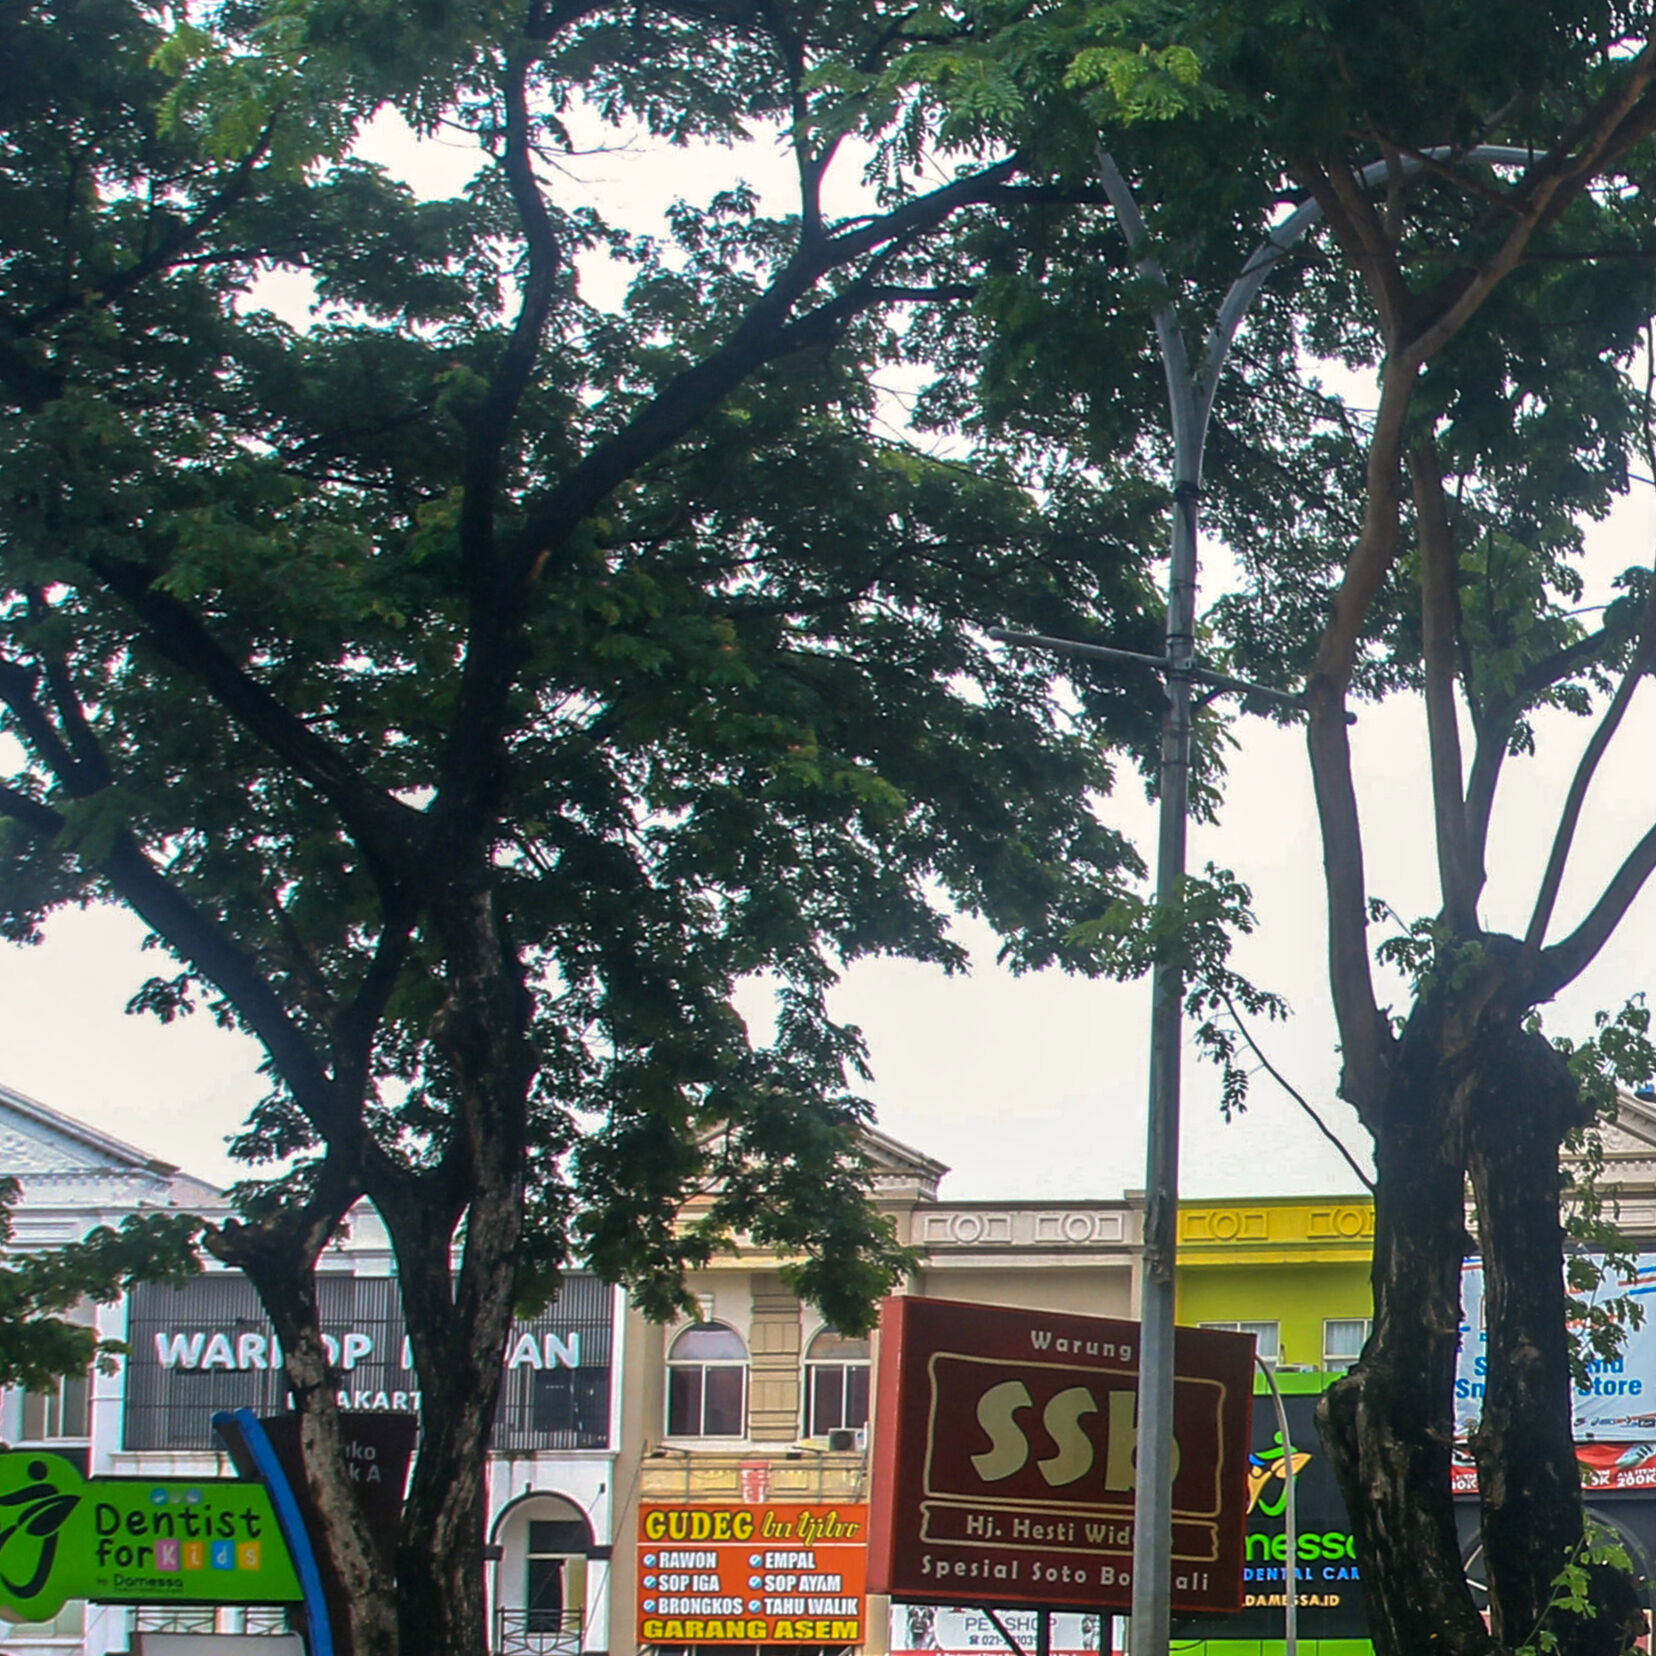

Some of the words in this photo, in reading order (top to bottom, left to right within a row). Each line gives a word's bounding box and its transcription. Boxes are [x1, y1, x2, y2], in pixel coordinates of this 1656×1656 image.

[1030, 1330, 1132, 1361] Warung
[95, 1502, 262, 1538] Dentist
[644, 1510, 755, 1541] GUDEG
[965, 1514, 1002, 1539] Hj.
[1012, 1518, 1075, 1541] Hesti
[96, 1540, 153, 1569] for
[657, 1552, 718, 1569] RAWON
[764, 1552, 817, 1570] EMPAL
[921, 1555, 1019, 1581] Spesial
[1031, 1562, 1087, 1584] Soto
[658, 1574, 692, 1593] SOP
[692, 1574, 721, 1593] IGA
[764, 1575, 798, 1593] SOP
[798, 1574, 842, 1593] AYAM
[656, 1597, 744, 1616] BRONGKOS
[764, 1598, 806, 1616] TAHU
[807, 1597, 859, 1616] WALIK
[642, 1619, 768, 1640] GARANG
[772, 1620, 859, 1640] ASEM
